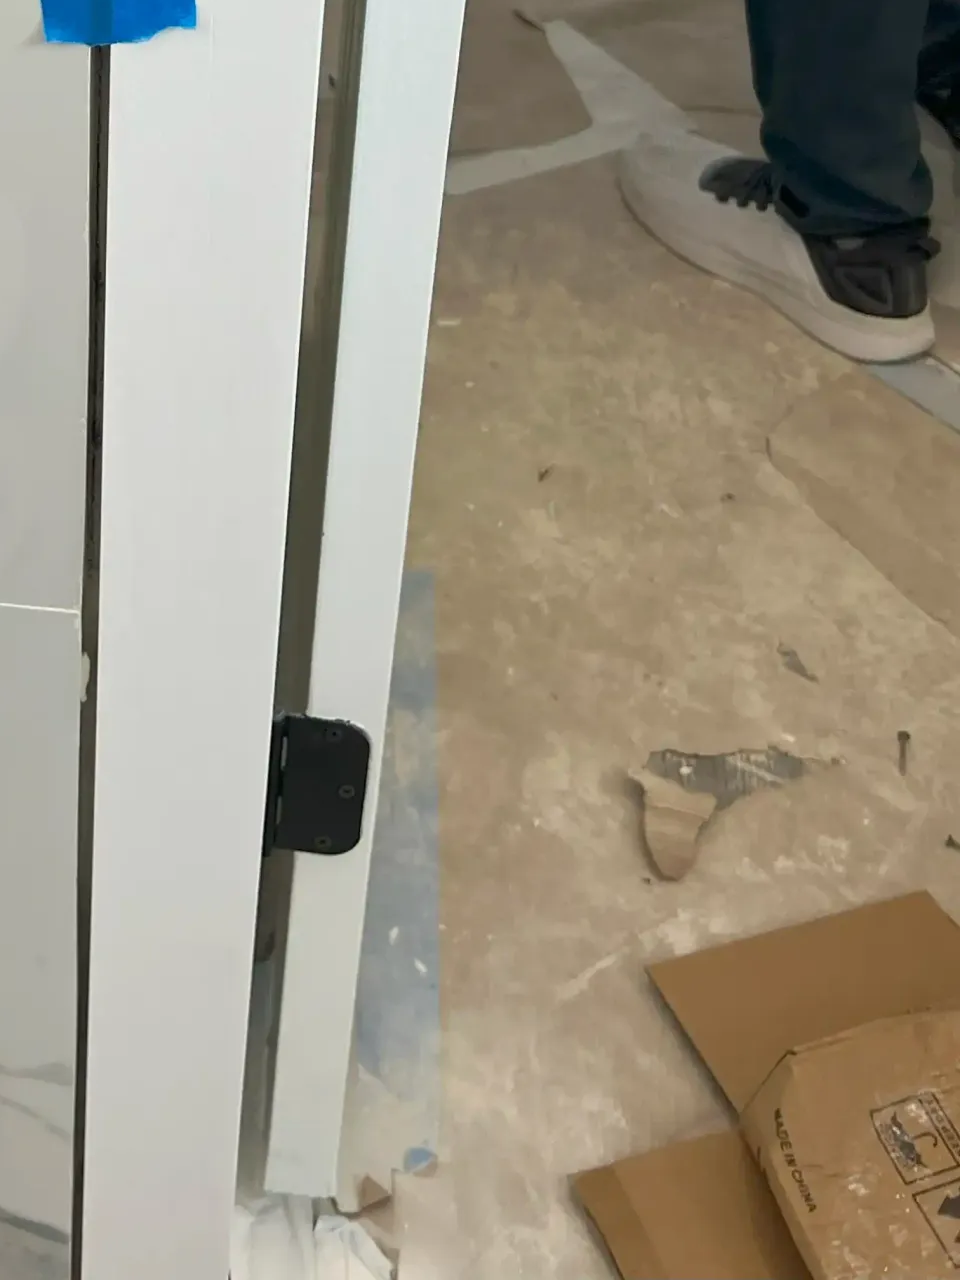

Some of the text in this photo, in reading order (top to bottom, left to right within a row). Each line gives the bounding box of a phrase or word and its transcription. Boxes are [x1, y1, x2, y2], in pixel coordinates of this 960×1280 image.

[774, 1108, 817, 1213] MADE IN CHINA
